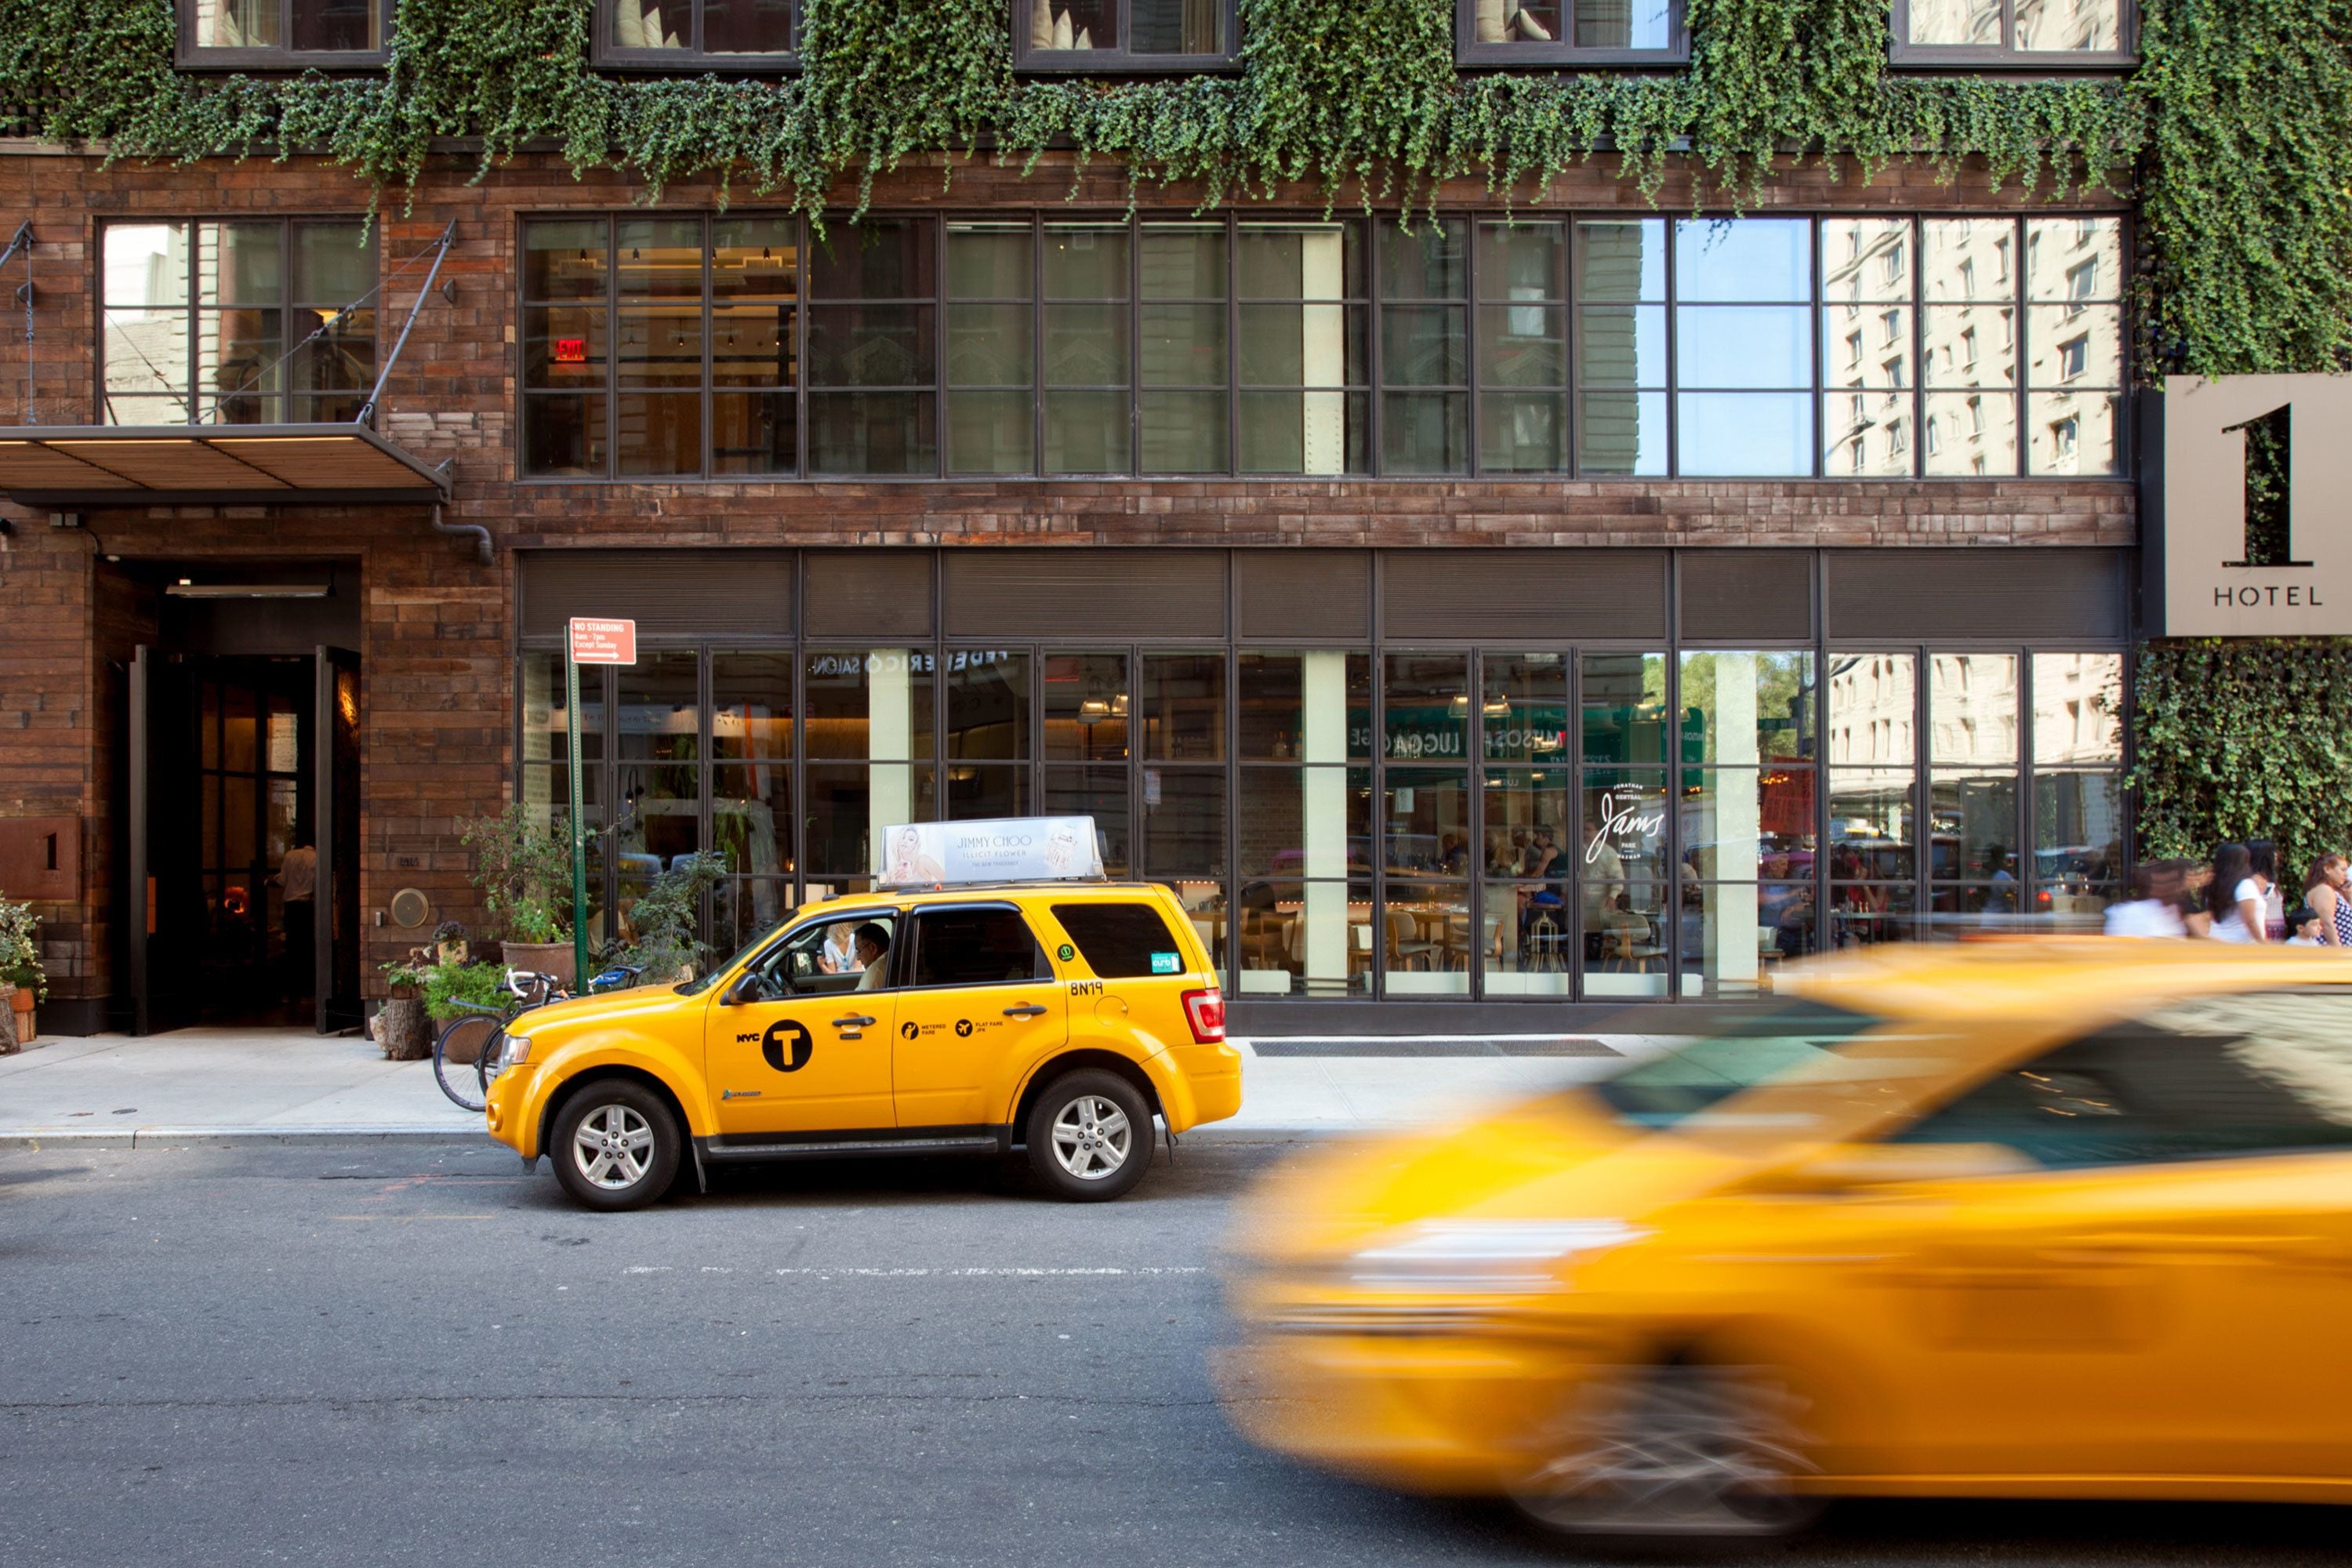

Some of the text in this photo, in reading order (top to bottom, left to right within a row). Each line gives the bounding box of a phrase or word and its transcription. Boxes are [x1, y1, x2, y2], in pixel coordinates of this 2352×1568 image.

[559, 339, 582, 359] EXIT
[2221, 402, 2314, 567] 1
[2214, 586, 2323, 607] HOTEL
[575, 622, 624, 633] NO STANDING
[596, 641, 617, 650] Sunday
[1585, 793, 1664, 863] Jams
[42, 833, 60, 870] 1
[957, 835, 1032, 848] JIMMY CHOO
[1071, 982, 1103, 996] 8N19
[737, 1029, 800, 1065] NYC T
